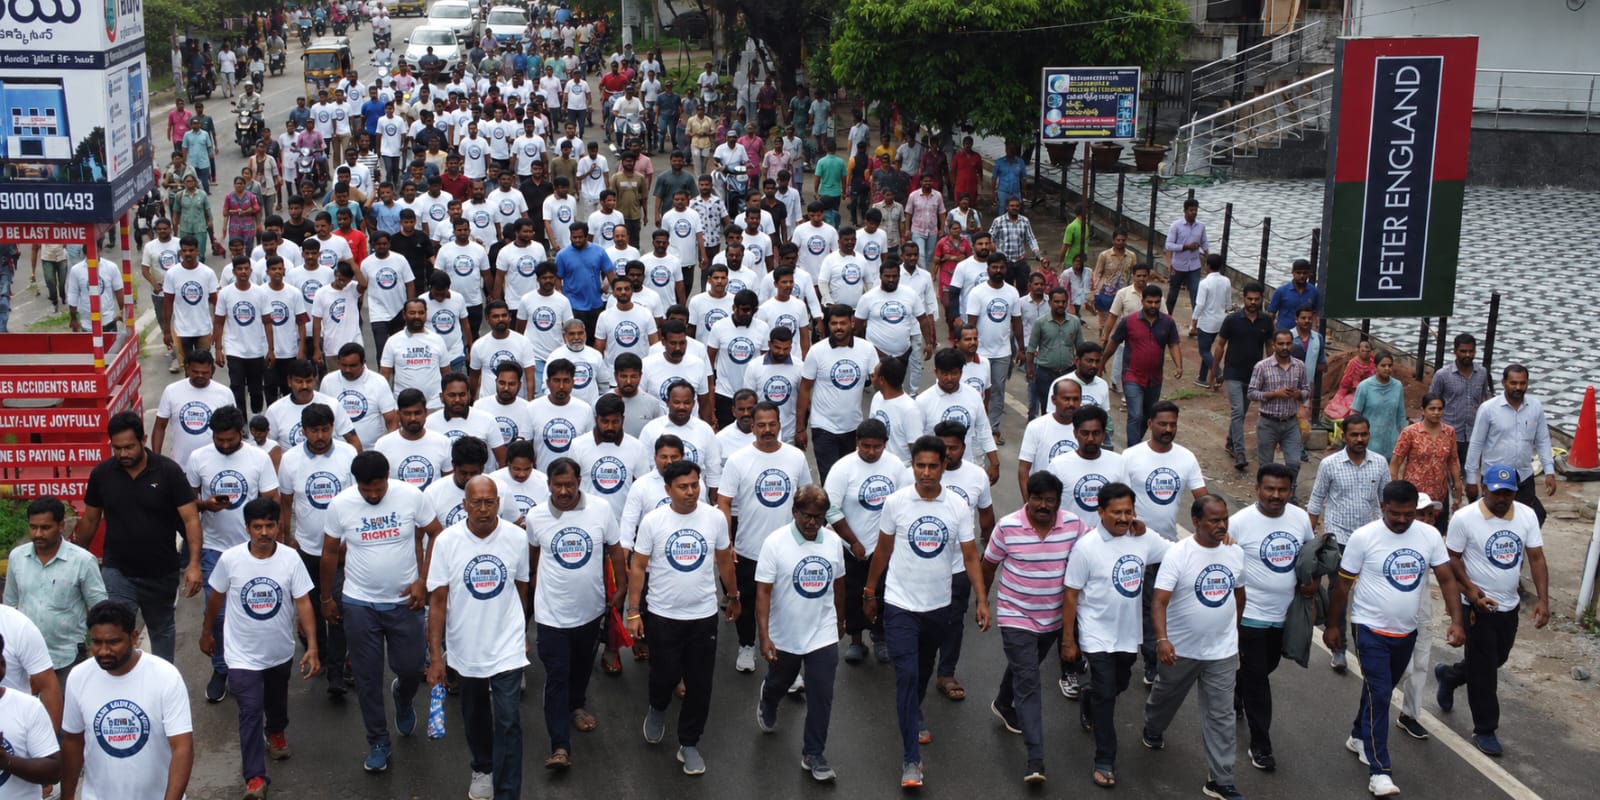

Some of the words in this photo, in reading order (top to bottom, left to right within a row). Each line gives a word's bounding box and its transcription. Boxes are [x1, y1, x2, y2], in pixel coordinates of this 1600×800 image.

[1385, 65, 1421, 208] ENGLAND
[0, 192, 40, 210] 91001
[44, 192, 94, 210] 00493
[6, 226, 20, 239] BE
[23, 226, 49, 239] LAST
[53, 226, 86, 240] DRIVE
[1378, 215, 1409, 290] PETER
[0, 381, 14, 393] ES
[16, 380, 69, 393] ACCIDENTS
[71, 380, 97, 393] RARE
[49, 414, 101, 427] JOYFULLY
[16, 449, 26, 462] IS
[29, 449, 65, 462] PAYING
[69, 449, 76, 461] A
[39, 482, 88, 496] DISAST
[361, 528, 400, 541] RIGHTS
